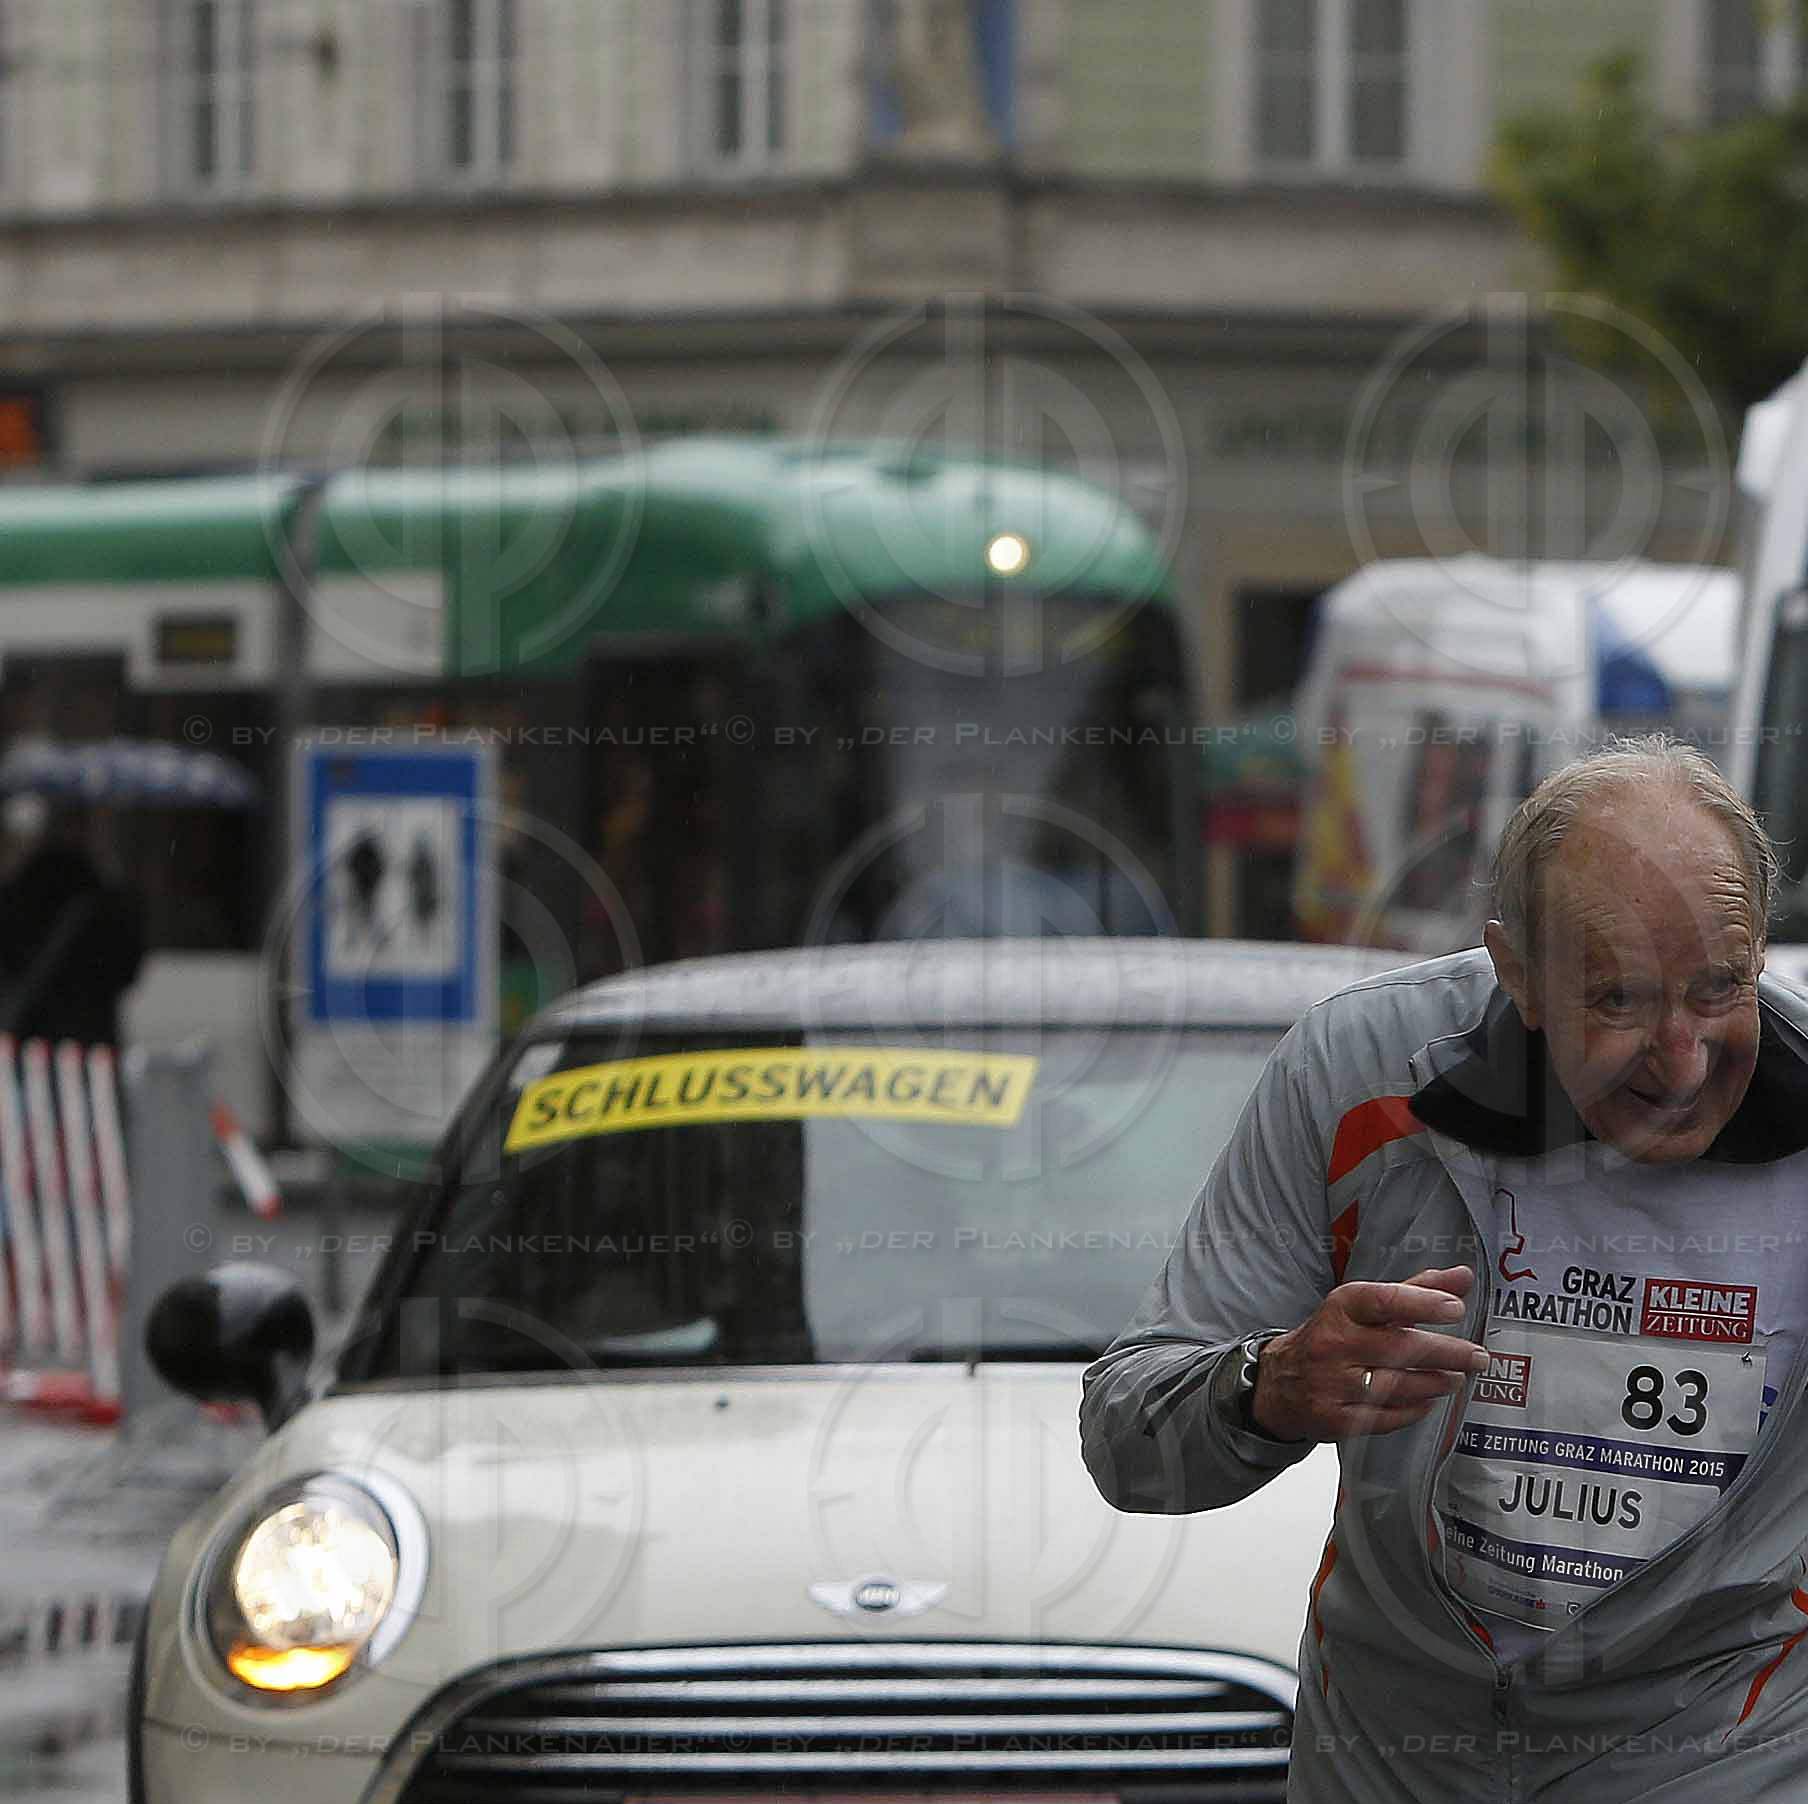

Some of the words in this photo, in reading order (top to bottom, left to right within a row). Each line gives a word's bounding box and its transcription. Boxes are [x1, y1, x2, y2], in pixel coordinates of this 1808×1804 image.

[529, 1064, 1009, 1129] SCHLUSSWAGEN
[1562, 1266, 1637, 1303] GRAZ
[1649, 1285, 1750, 1315] KLEINE
[1647, 1314, 1749, 1339] ZEITUNG
[1620, 1365, 1710, 1437] 83
[1483, 1434, 1549, 1455] ZEITUNG
[1555, 1441, 1595, 1462] GRAZ
[1600, 1447, 1684, 1474] MARATHON
[1688, 1459, 1725, 1478] 2015
[1498, 1473, 1643, 1530] JULIUS
[1446, 1526, 1474, 1549] eine
[1480, 1536, 1536, 1573] Zeitung
[1541, 1553, 1624, 1582] Marathon
